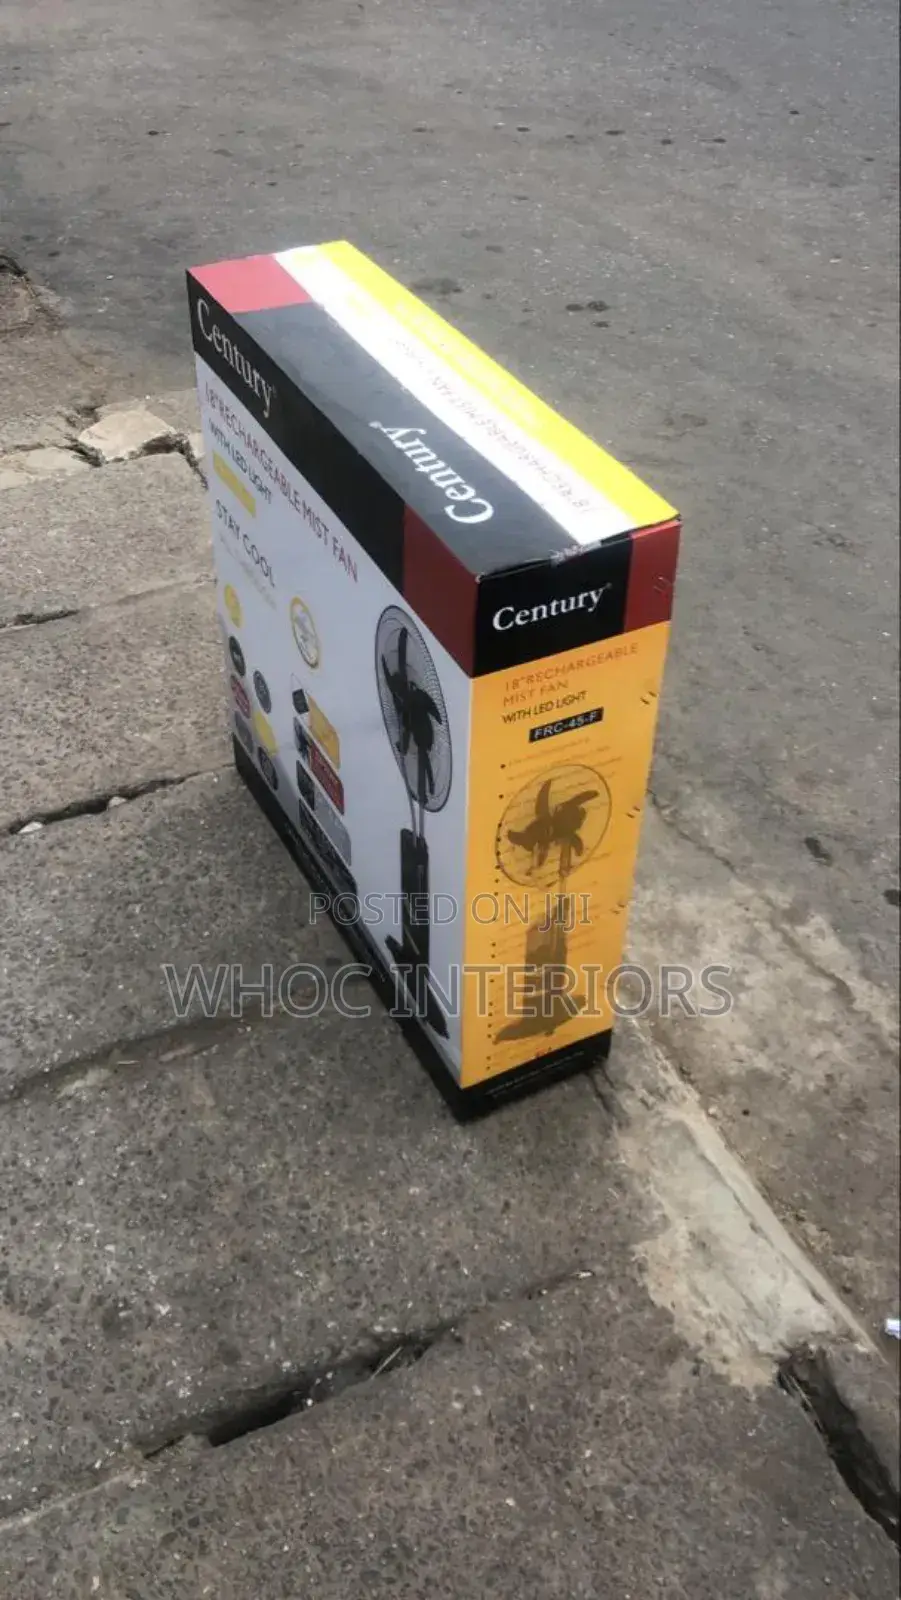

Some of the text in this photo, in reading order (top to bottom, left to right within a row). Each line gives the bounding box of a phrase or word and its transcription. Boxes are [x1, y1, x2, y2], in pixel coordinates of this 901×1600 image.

[197, 298, 273, 418] Century
[385, 427, 494, 524] Century
[215, 499, 241, 541] STAY
[242, 535, 276, 587] COOL
[303, 500, 329, 546] MIST
[332, 536, 358, 583] FAN
[492, 588, 604, 631] Century
[502, 691, 587, 724] WITH LED LIGHT
[503, 680, 568, 708] MIST FAN
